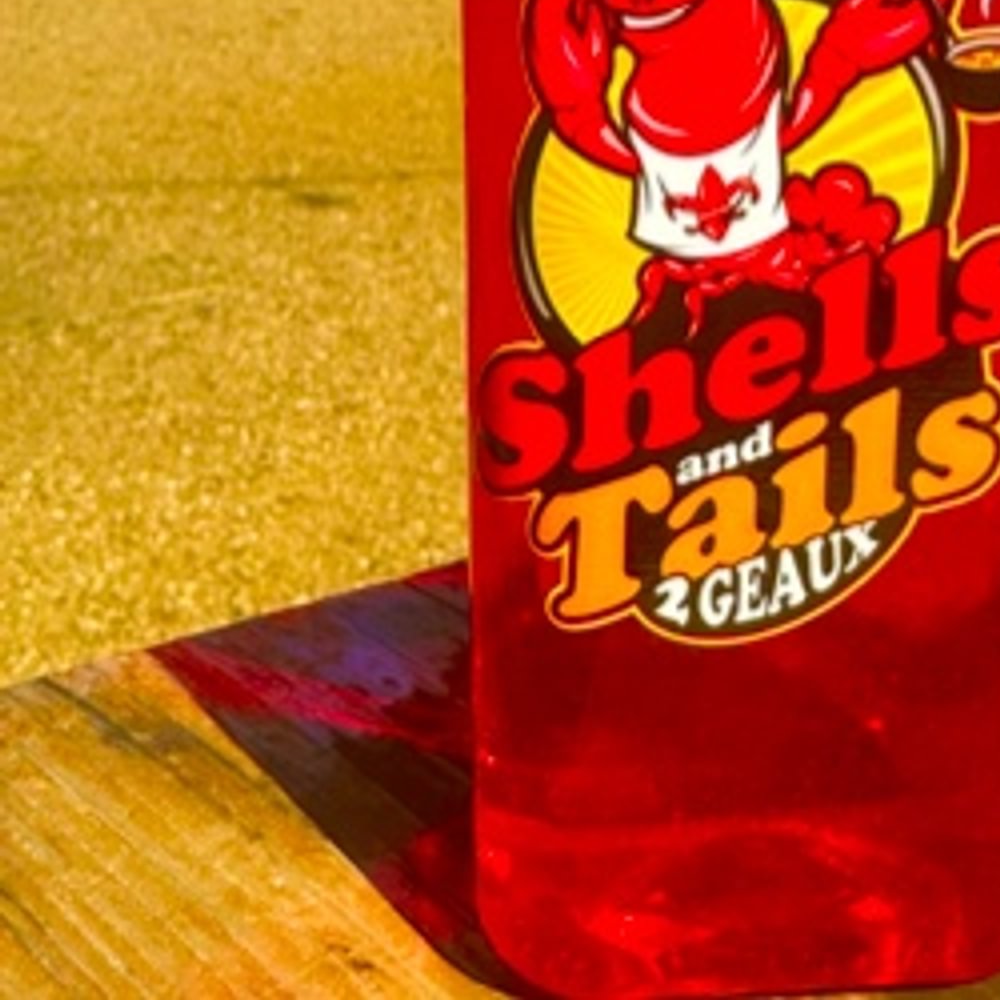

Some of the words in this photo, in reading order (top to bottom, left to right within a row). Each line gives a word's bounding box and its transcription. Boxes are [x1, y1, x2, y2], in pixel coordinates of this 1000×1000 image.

[536, 387, 998, 617] Tails
[676, 422, 774, 486] and
[698, 520, 880, 628] GEAUX
